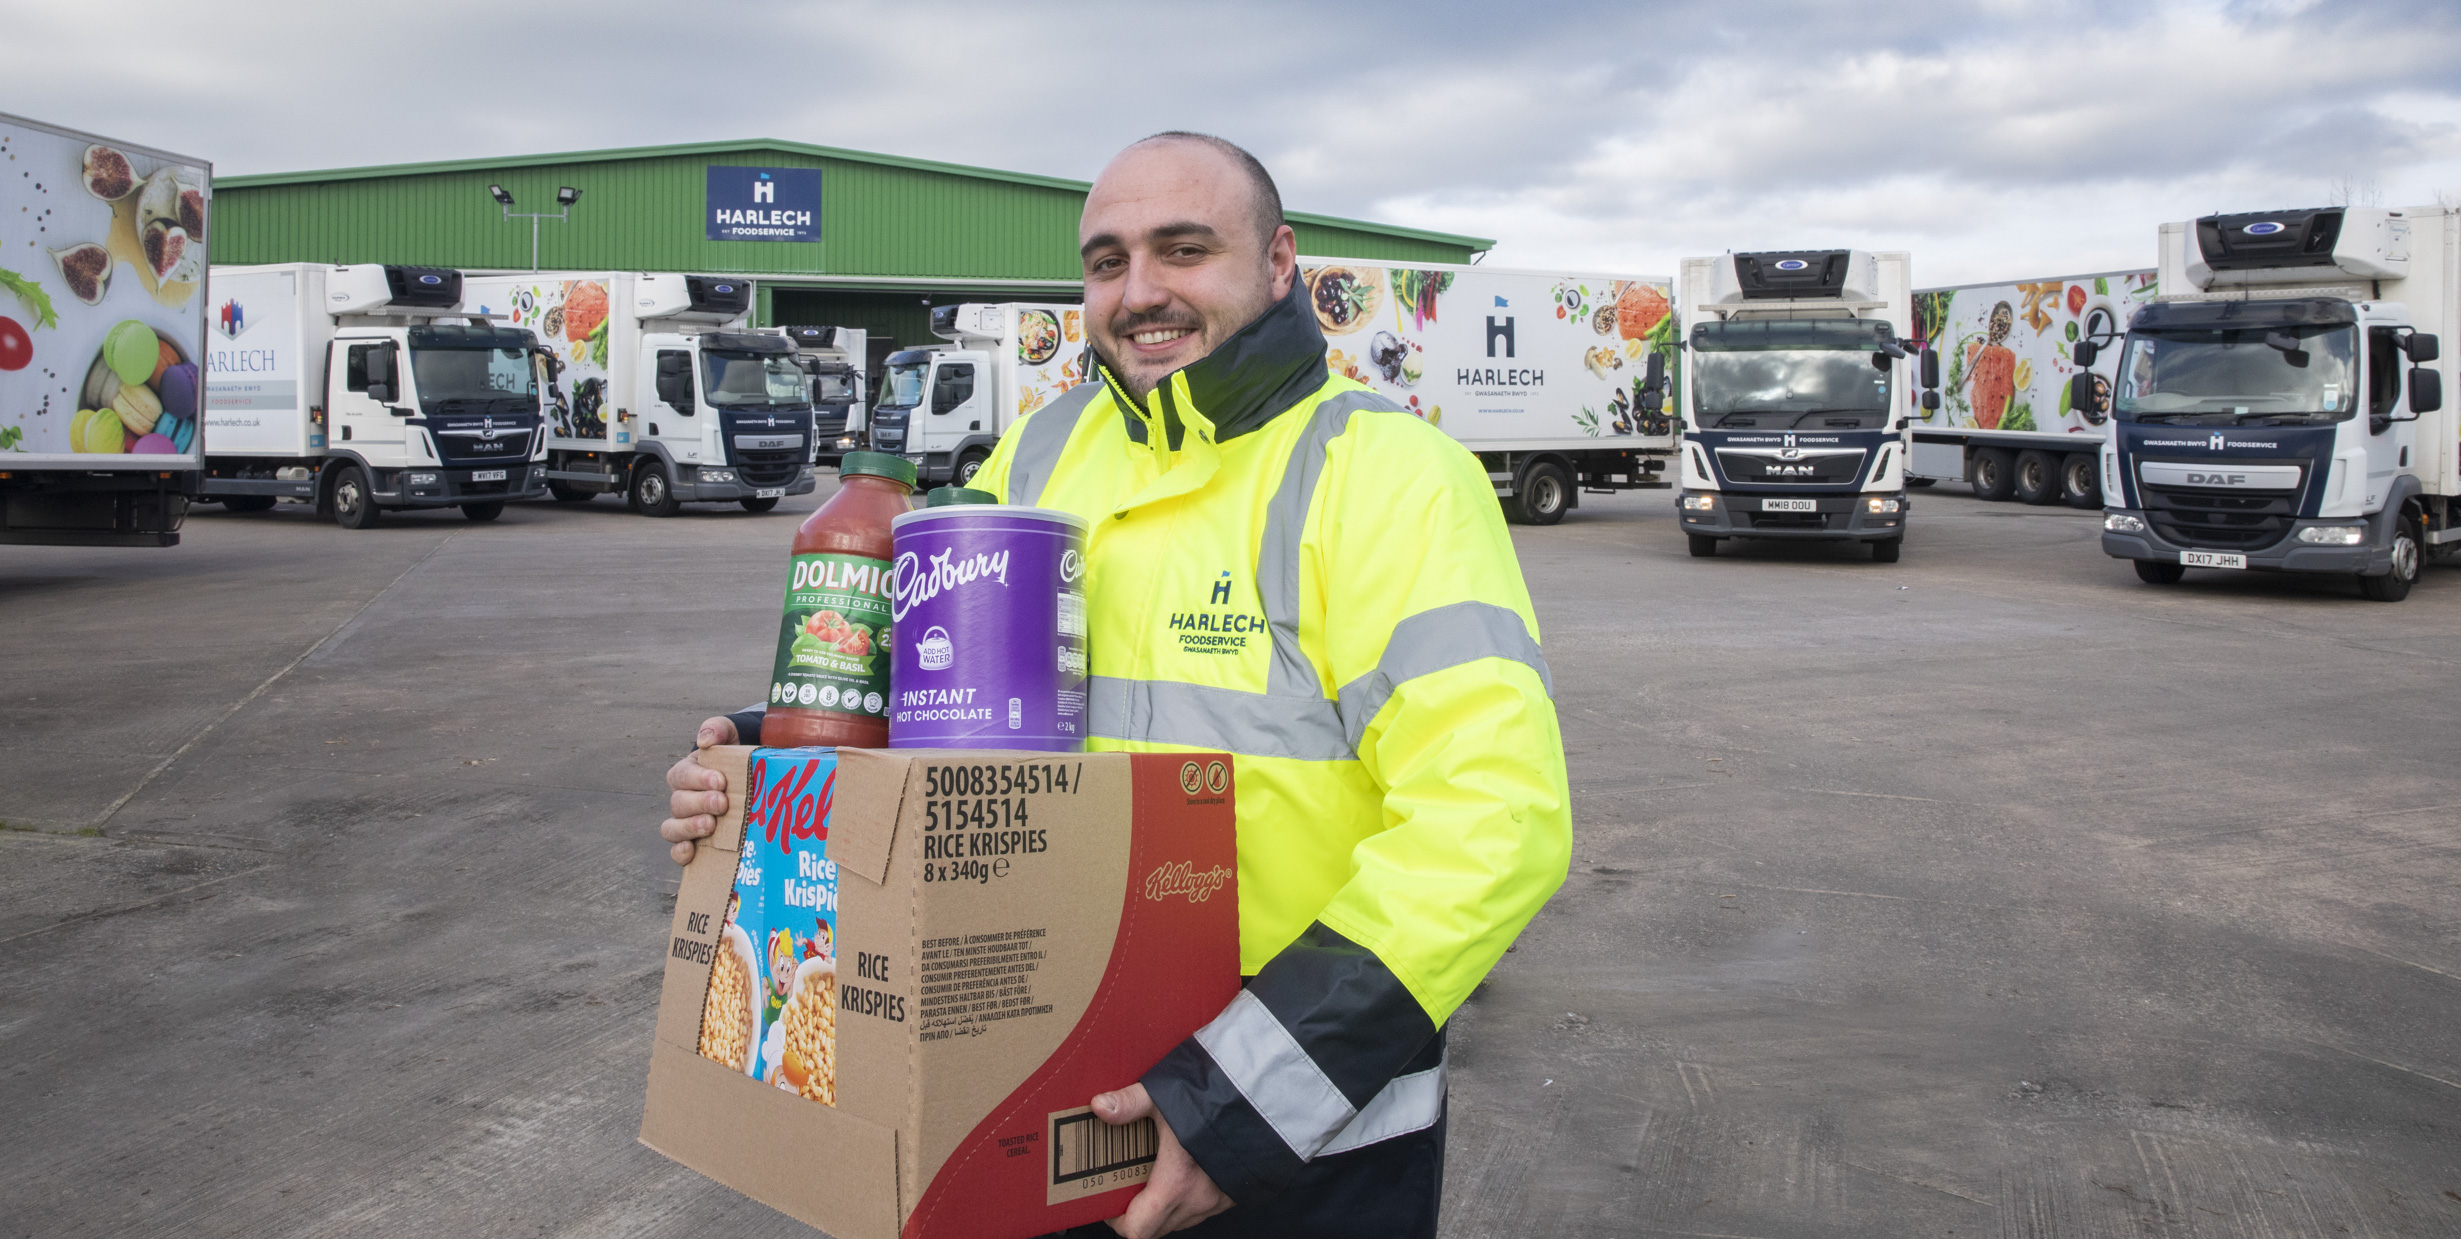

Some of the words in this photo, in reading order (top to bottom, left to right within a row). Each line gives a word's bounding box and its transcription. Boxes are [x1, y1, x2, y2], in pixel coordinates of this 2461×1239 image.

[716, 209, 810, 226] HARLECH
[732, 227, 794, 236] FOODSERVICE
[206, 350, 275, 372] ARLECH
[1457, 368, 1544, 386] HARLECH
[473, 443, 503, 451] MAN
[2227, 441, 2277, 449] FOODSERVICE
[1766, 465, 1814, 475] MAN
[2187, 473, 2245, 485] DAF
[2188, 554, 2212, 564] DX17
[2216, 555, 2239, 566] JHH
[892, 547, 1009, 622] Cadbury
[796, 596, 886, 612] PROFESSIONAL
[1169, 613, 1265, 633] HARLECH
[936, 646, 949, 654] HOT
[1179, 635, 1246, 647] FOODSERVICE
[1184, 646, 1220, 654] GWASANAETH
[796, 654, 829, 666] TOMATO
[830, 660, 838, 668] &
[840, 661, 865, 672] BASIL
[923, 654, 950, 664] WATER
[900, 688, 976, 706] INSTANT
[897, 711, 911, 723] HOT
[914, 708, 992, 721] CHOCOLATE
[925, 764, 1068, 797] 5008354514
[1073, 762, 1082, 794] /
[765, 759, 836, 855] Kel
[924, 798, 1028, 831] 5154514
[924, 834, 964, 859] RICE
[970, 829, 1047, 857] KRISPIES
[798, 850, 836, 881] Rice
[924, 862, 934, 882] 8
[938, 866, 947, 882] x
[951, 860, 988, 884] 340g
[1146, 860, 1225, 903] Kellogg's
[687, 912, 710, 934] RICE
[922, 940, 937, 949] BEST
[938, 937, 959, 947] BEFORE
[964, 934, 968, 945] À
[969, 932, 1004, 944] CONSOMMER
[1005, 932, 1012, 940] DE
[1014, 928, 1046, 940] PRÉFÉRENCE
[672, 937, 713, 965] KRISPIES
[922, 950, 941, 960] AVANT
[942, 949, 949, 958] LE
[954, 947, 965, 957] TEN
[965, 945, 986, 956] MINSTE
[988, 942, 1018, 954] HOUDBAAR
[1019, 942, 1028, 950] TOT
[922, 962, 930, 972] DA
[931, 959, 968, 971] CONSUMARSI
[969, 954, 1019, 967] PREFERIBILMENTE
[1020, 951, 1037, 961] ENTRO
[1038, 950, 1043, 959] IL
[858, 952, 888, 982] RICE
[921, 972, 952, 983] CONSUMIR
[954, 966, 1006, 979] PREFERENTEMENTE
[1008, 964, 1024, 974] ANTES
[1026, 963, 1035, 971] DEL
[921, 984, 952, 995] CONSUMIR
[953, 982, 960, 991] DE
[1000, 976, 1017, 985] ANTES
[1018, 975, 1025, 984] DE
[842, 984, 905, 1023] KRISPIES
[921, 995, 958, 1007] MINDESTENS
[960, 991, 985, 1002] HALTBAR
[986, 990, 995, 999] BIS
[1000, 987, 1013, 996] BÄST
[1014, 985, 1028, 995] FÖRE
[921, 1008, 946, 1018] PARASTA
[948, 1005, 967, 1016] ENNEN
[972, 1002, 985, 1012] BEST
[987, 1001, 997, 1010] FØR
[1002, 998, 1018, 1008] BEDST
[1020, 996, 1030, 1006] FØR
[998, 1134, 1024, 1148] TOASTED
[1026, 1132, 1039, 1142] RICE
[1007, 1146, 1031, 1157] CEREAL.
[1082, 1175, 1103, 1189] 050
[1113, 1165, 1147, 1181] 50083
